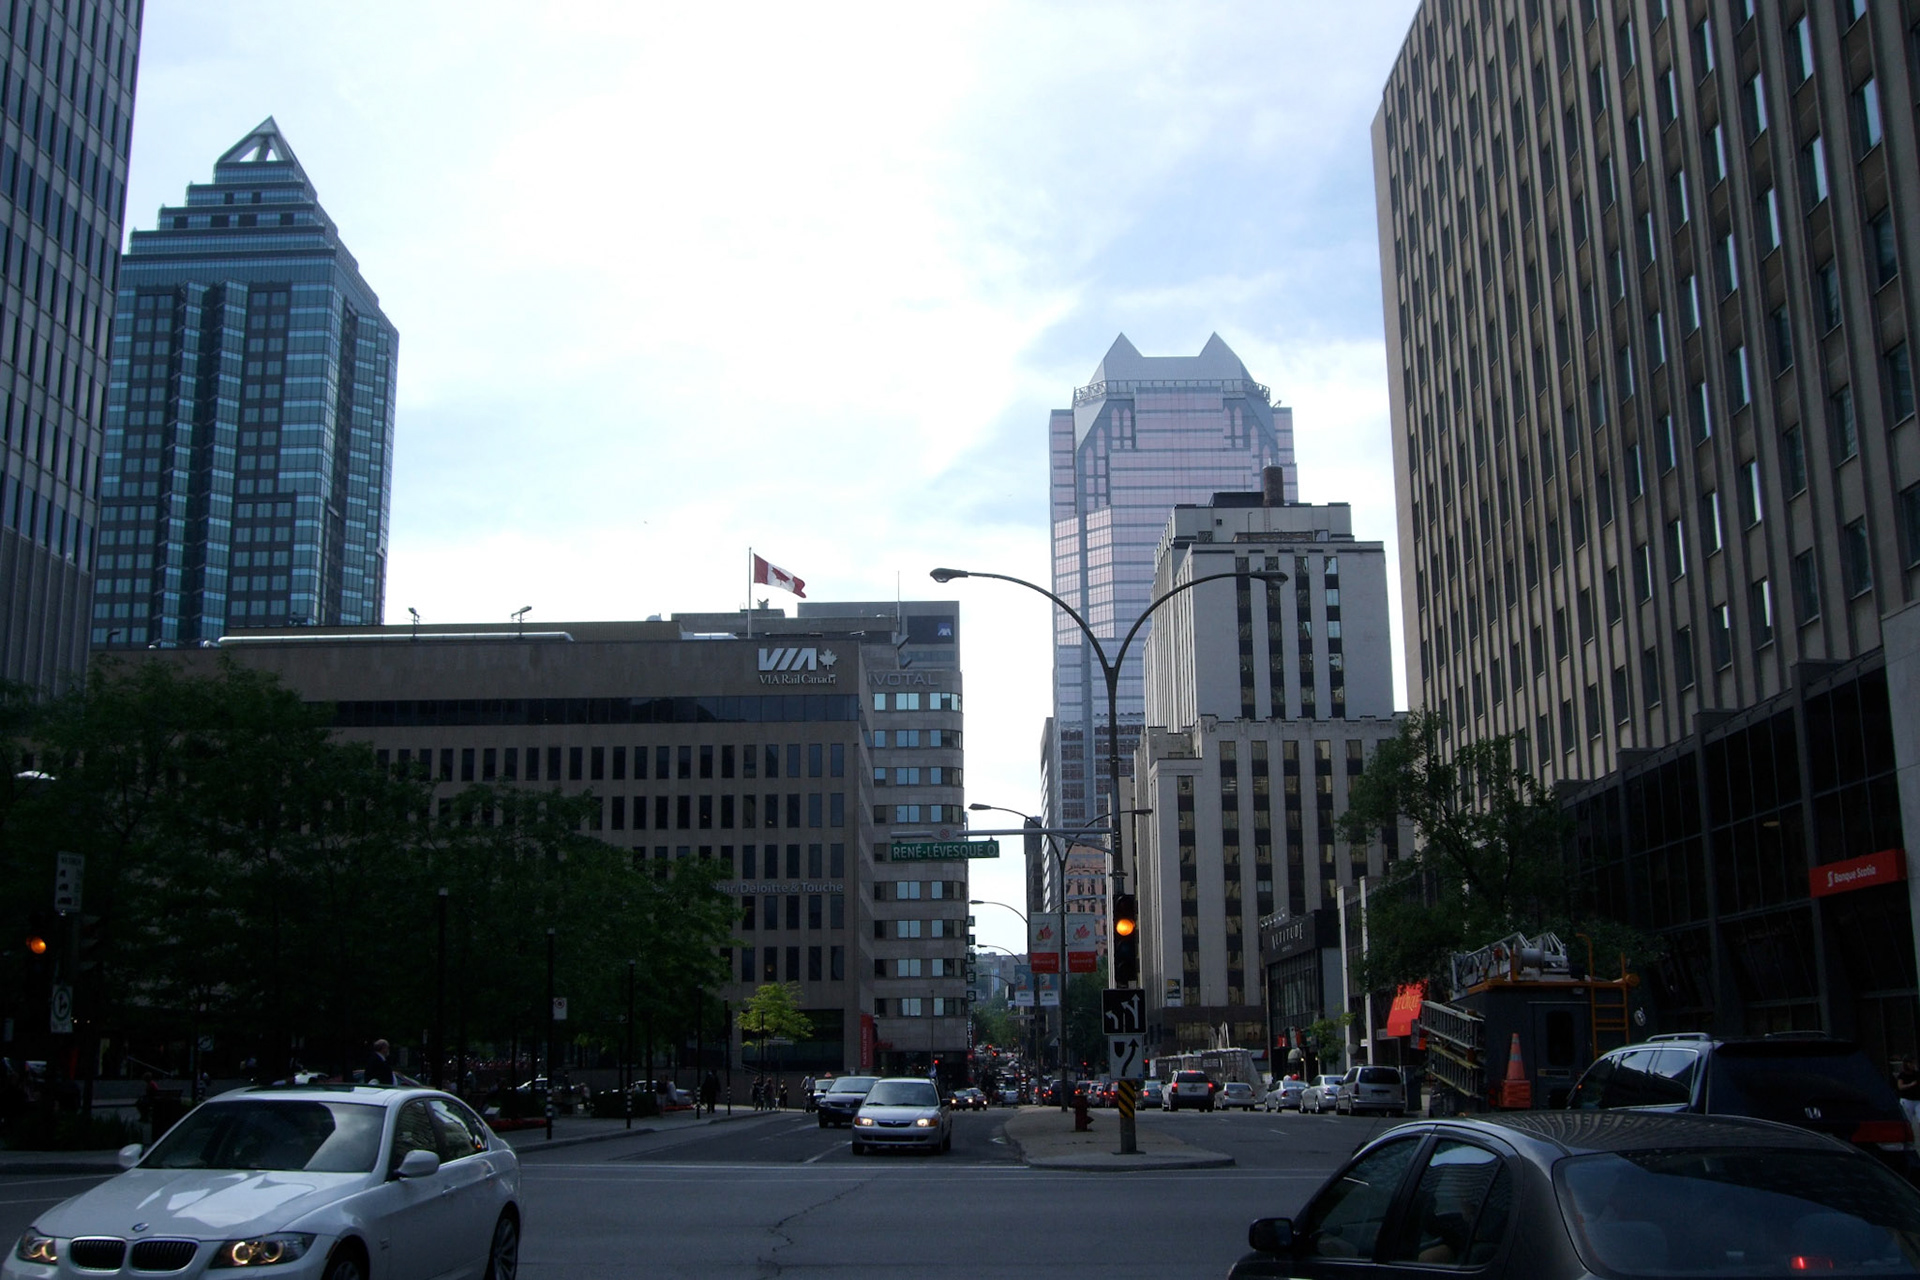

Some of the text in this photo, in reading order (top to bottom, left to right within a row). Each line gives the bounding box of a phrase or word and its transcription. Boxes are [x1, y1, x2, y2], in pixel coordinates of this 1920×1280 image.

[758, 647, 817, 671] VIA
[760, 674, 780, 684] VIA
[781, 673, 800, 684] Rail
[893, 843, 983, 858] RENÉ-LÉVESQUE
[790, 882, 800, 893] &
[802, 881, 844, 893] Touche
